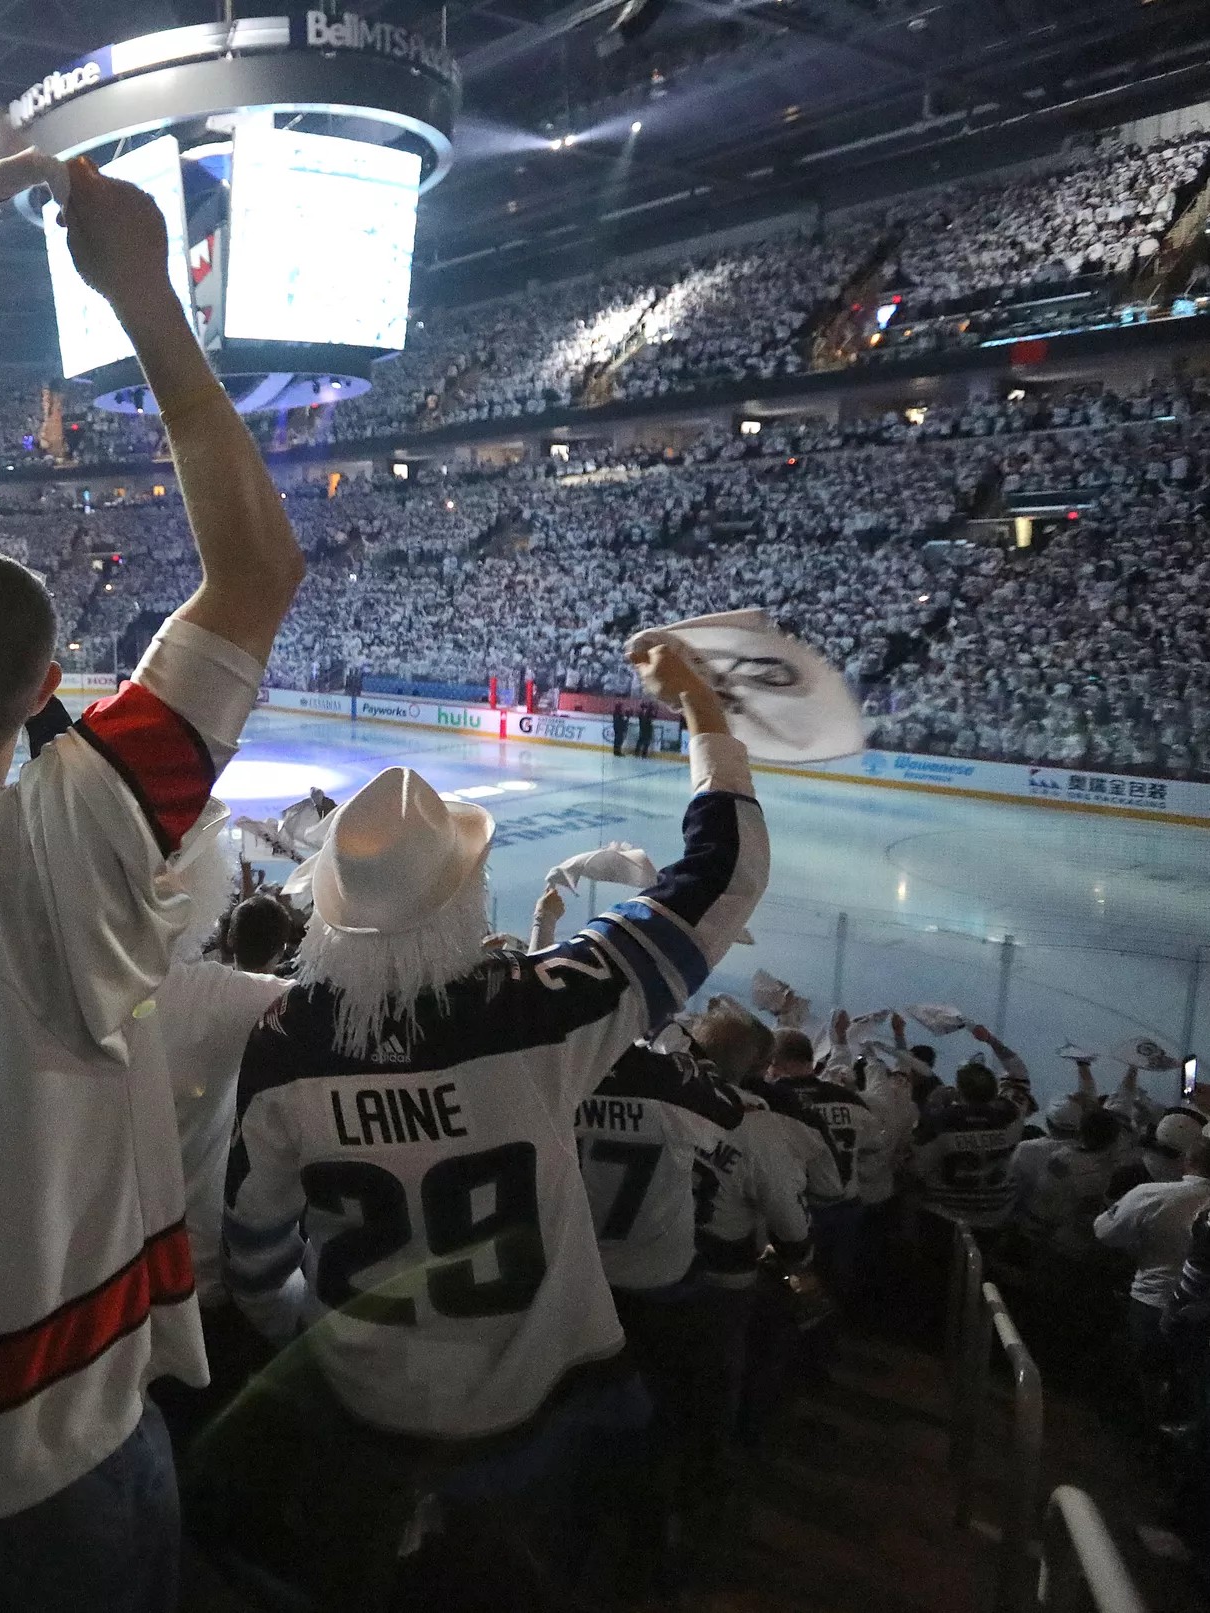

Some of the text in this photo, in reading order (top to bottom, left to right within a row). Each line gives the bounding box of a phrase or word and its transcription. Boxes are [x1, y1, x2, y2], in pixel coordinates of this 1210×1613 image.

[362, 702, 407, 717] Payworks
[437, 707, 482, 728] hulu
[535, 722, 586, 740] FROST
[330, 1082, 468, 1146] LAINE
[575, 1136, 665, 1241] 7
[300, 1141, 547, 1327] 29
